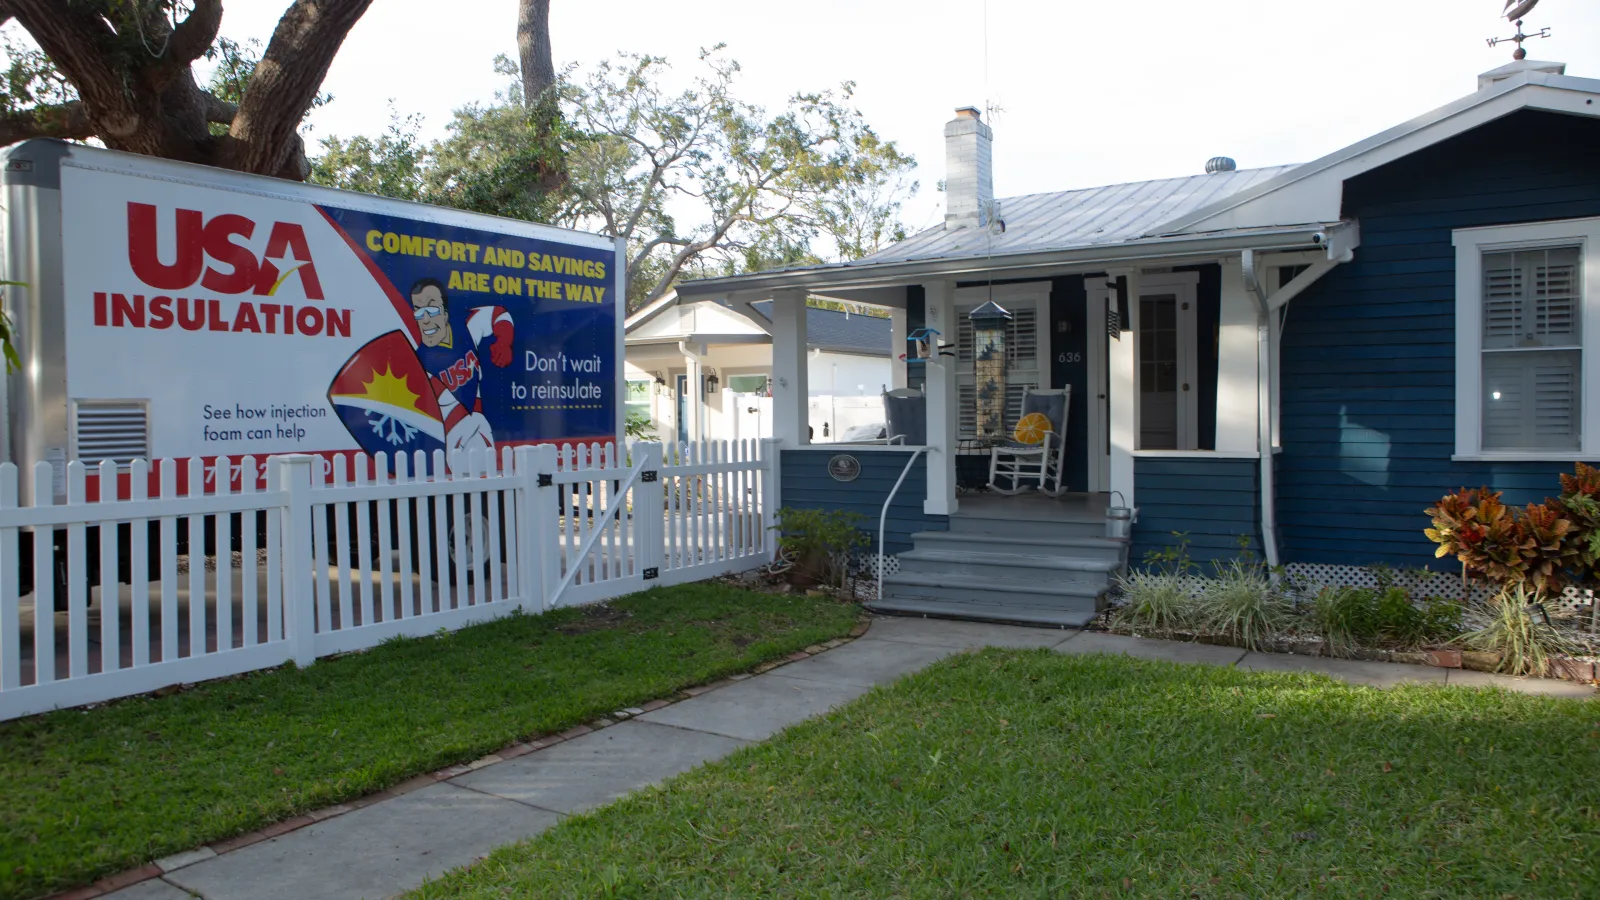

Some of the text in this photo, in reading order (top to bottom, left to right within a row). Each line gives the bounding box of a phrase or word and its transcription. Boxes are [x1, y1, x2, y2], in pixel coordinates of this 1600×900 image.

[127, 201, 325, 301] USA
[365, 229, 606, 279] COMFORT AND SAVINGS
[448, 270, 606, 304] ARE ON THE WAY
[93, 291, 352, 338] INSULATION
[439, 349, 481, 393] USA
[525, 350, 602, 373] Don't wait
[1058, 352, 1081, 363] 636
[511, 377, 602, 399] to reinsulate
[203, 403, 326, 422] See how injection
[203, 423, 306, 442] foam can help
